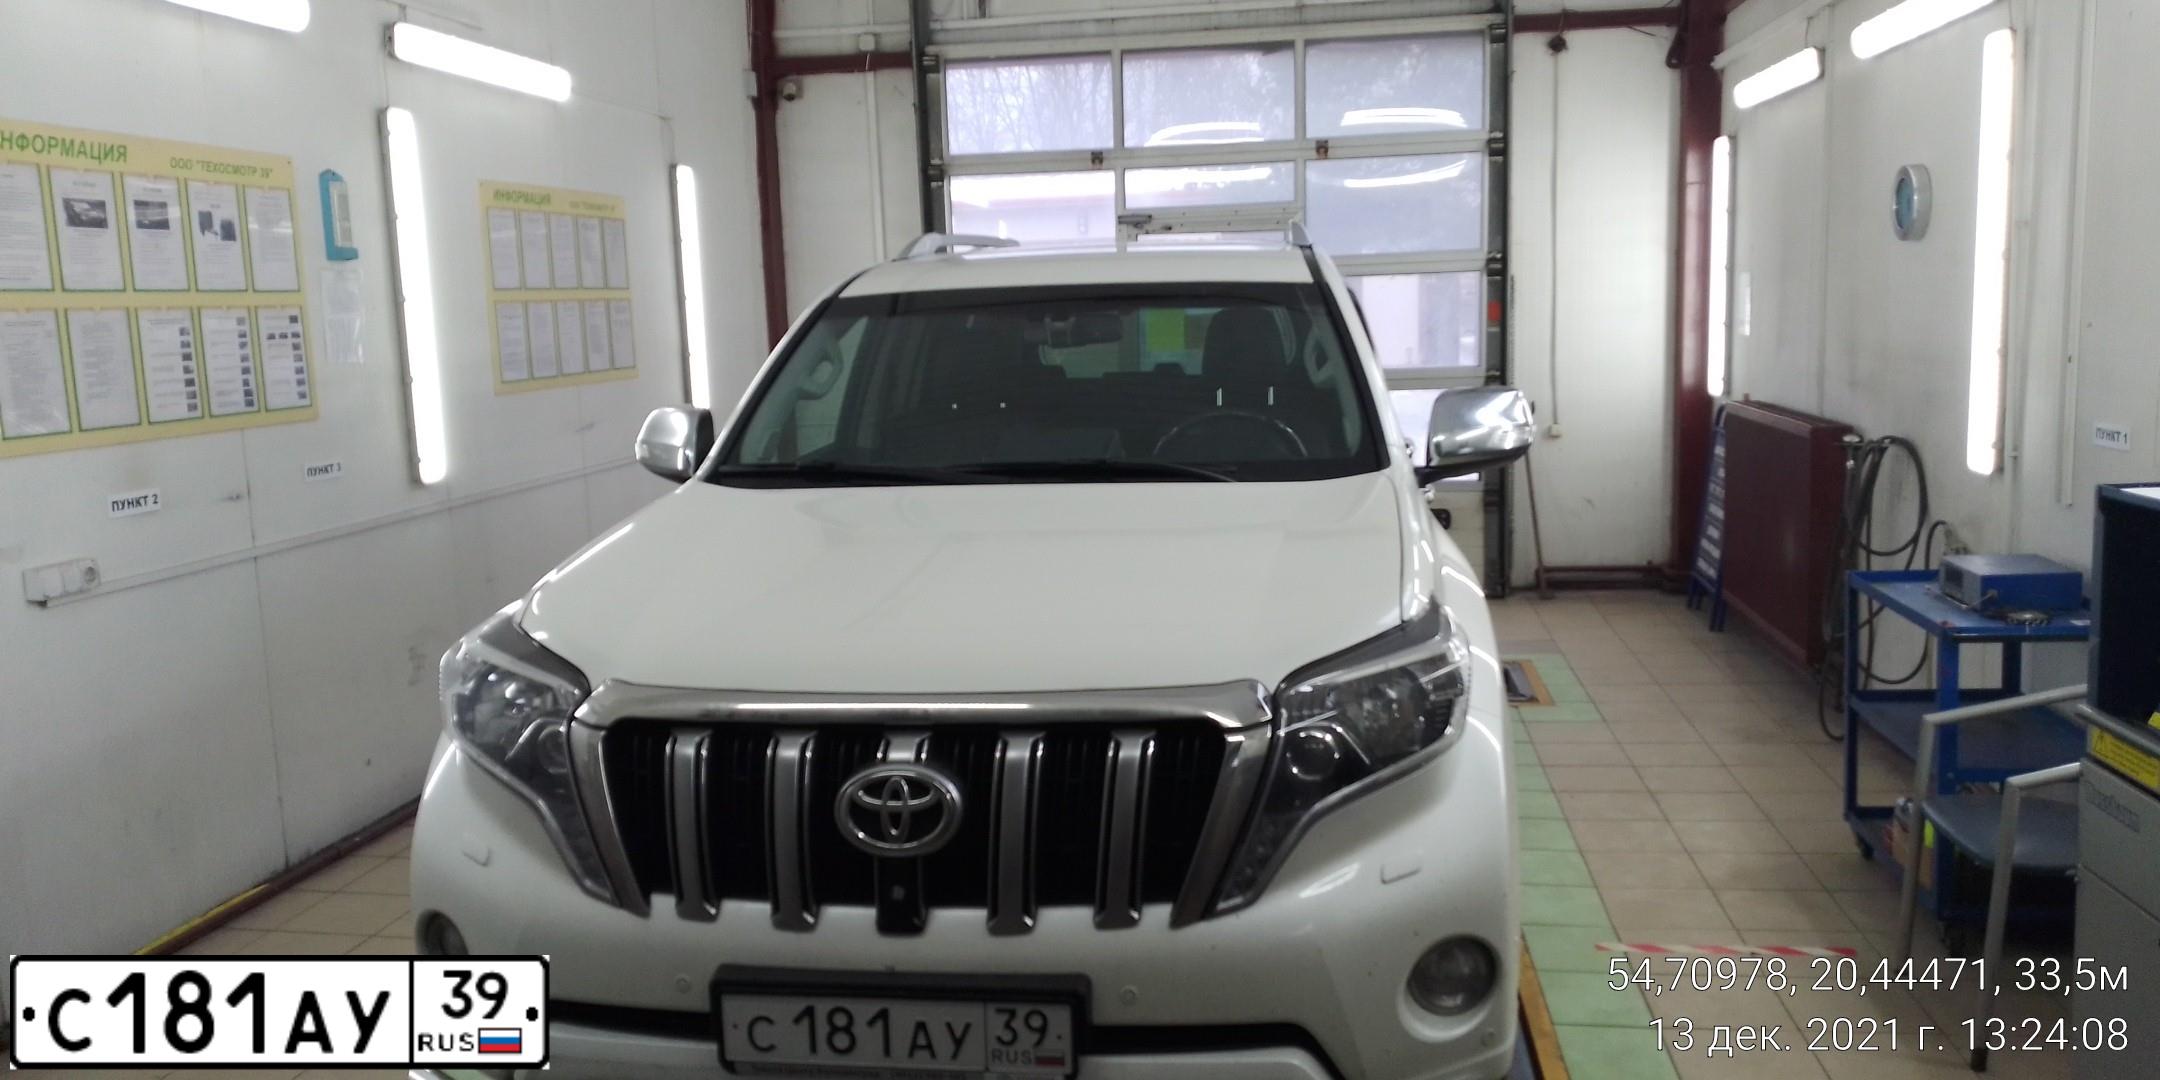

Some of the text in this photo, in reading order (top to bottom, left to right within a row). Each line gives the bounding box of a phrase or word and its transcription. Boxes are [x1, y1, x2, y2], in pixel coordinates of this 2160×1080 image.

[0, 129, 128, 164] НФОРМАЦИЯ
[169, 156, 193, 170] ООО
[2096, 427, 2128, 444] ПУНКТ 1
[306, 463, 334, 478] ПУНКТ
[111, 494, 159, 512] ПУНКТ 2
[995, 1009, 1048, 1047] 39
[992, 1049, 1033, 1065] RUS
